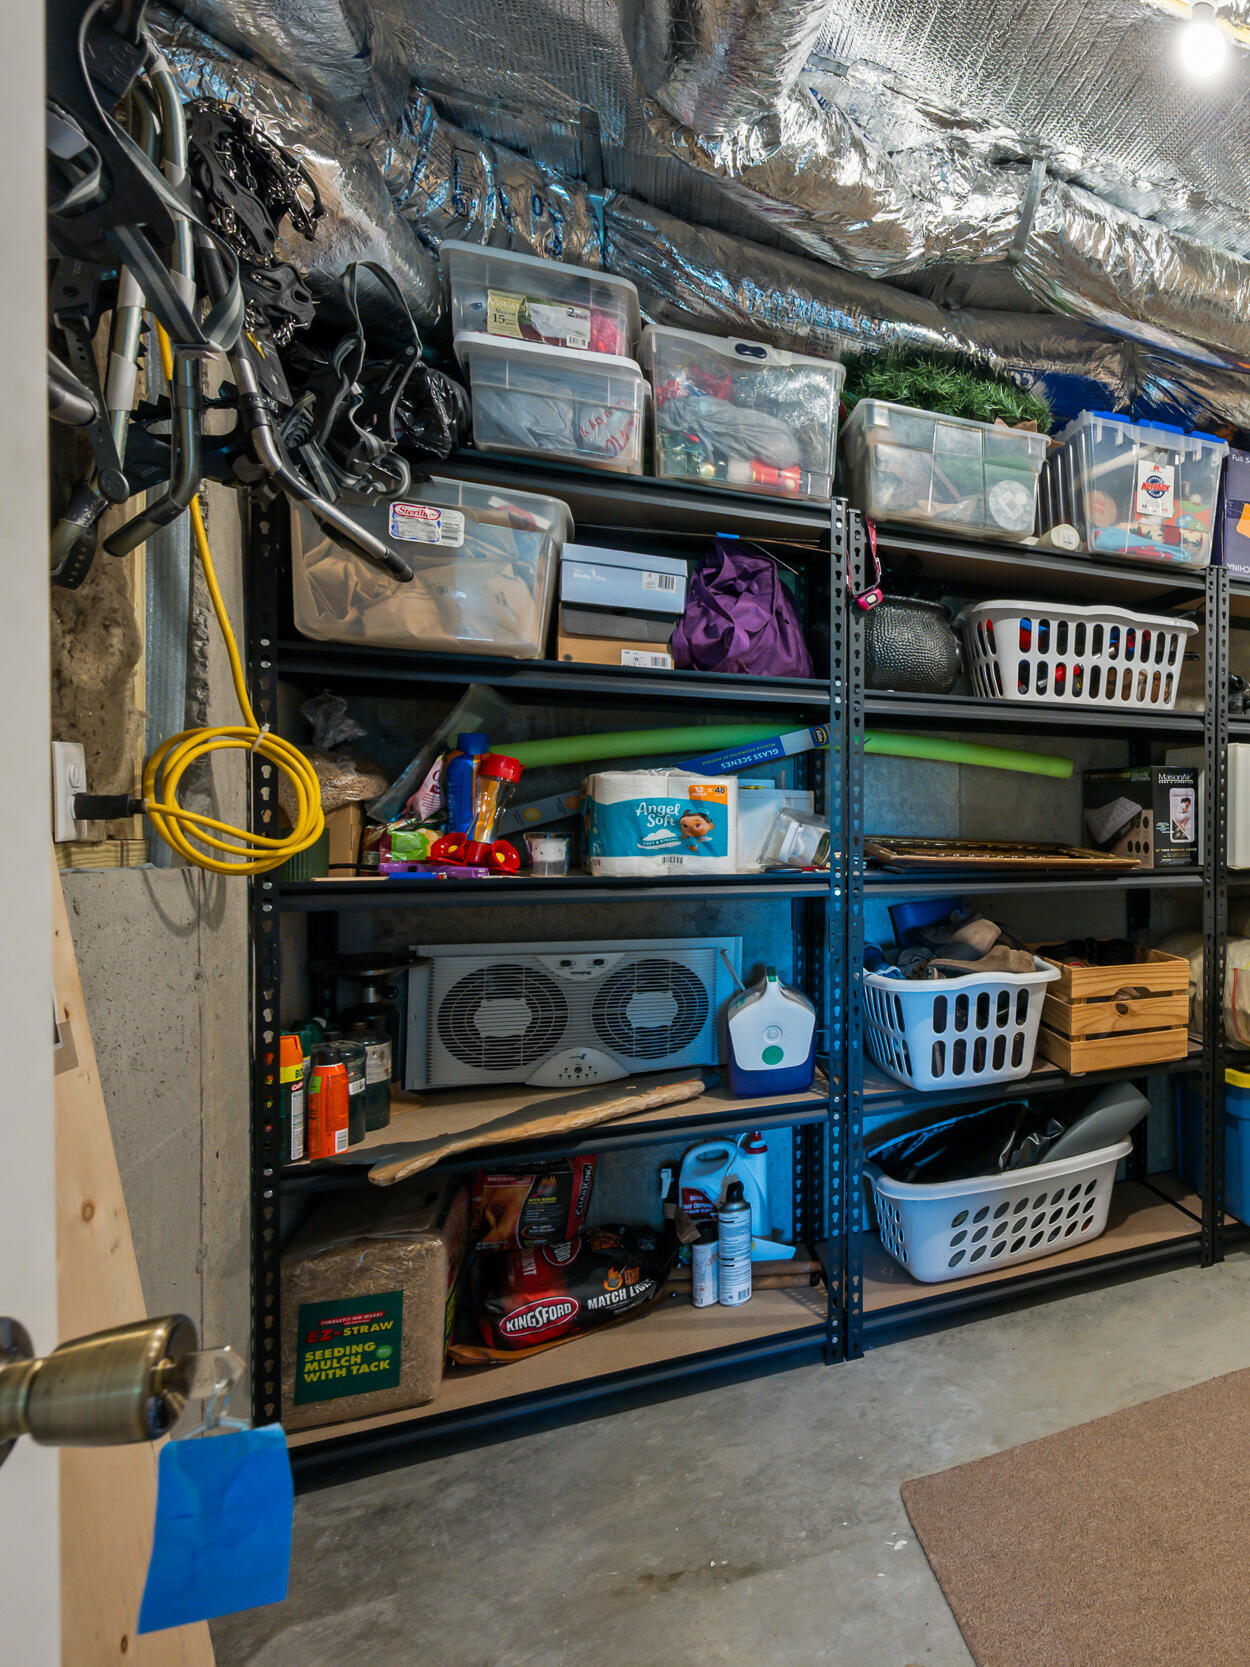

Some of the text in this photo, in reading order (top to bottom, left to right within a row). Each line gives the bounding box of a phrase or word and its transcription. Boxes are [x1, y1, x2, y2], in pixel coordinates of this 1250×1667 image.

[493, 313, 506, 323] 15
[567, 307, 575, 318] 2
[1227, 563, 1250, 574] CHINA
[720, 748, 779, 769] GLASS SCENES
[714, 786, 725, 794] 48
[636, 802, 681, 817] Angel
[647, 813, 676, 828] Soft
[588, 1287, 627, 1310] MATCH
[505, 1302, 572, 1332] KINGSFORD
[305, 1320, 394, 1345] EZ-STRAW
[304, 1341, 377, 1362] SEEDING
[303, 1359, 391, 1383] WITH TACK
[304, 1354, 362, 1373] MULCH
